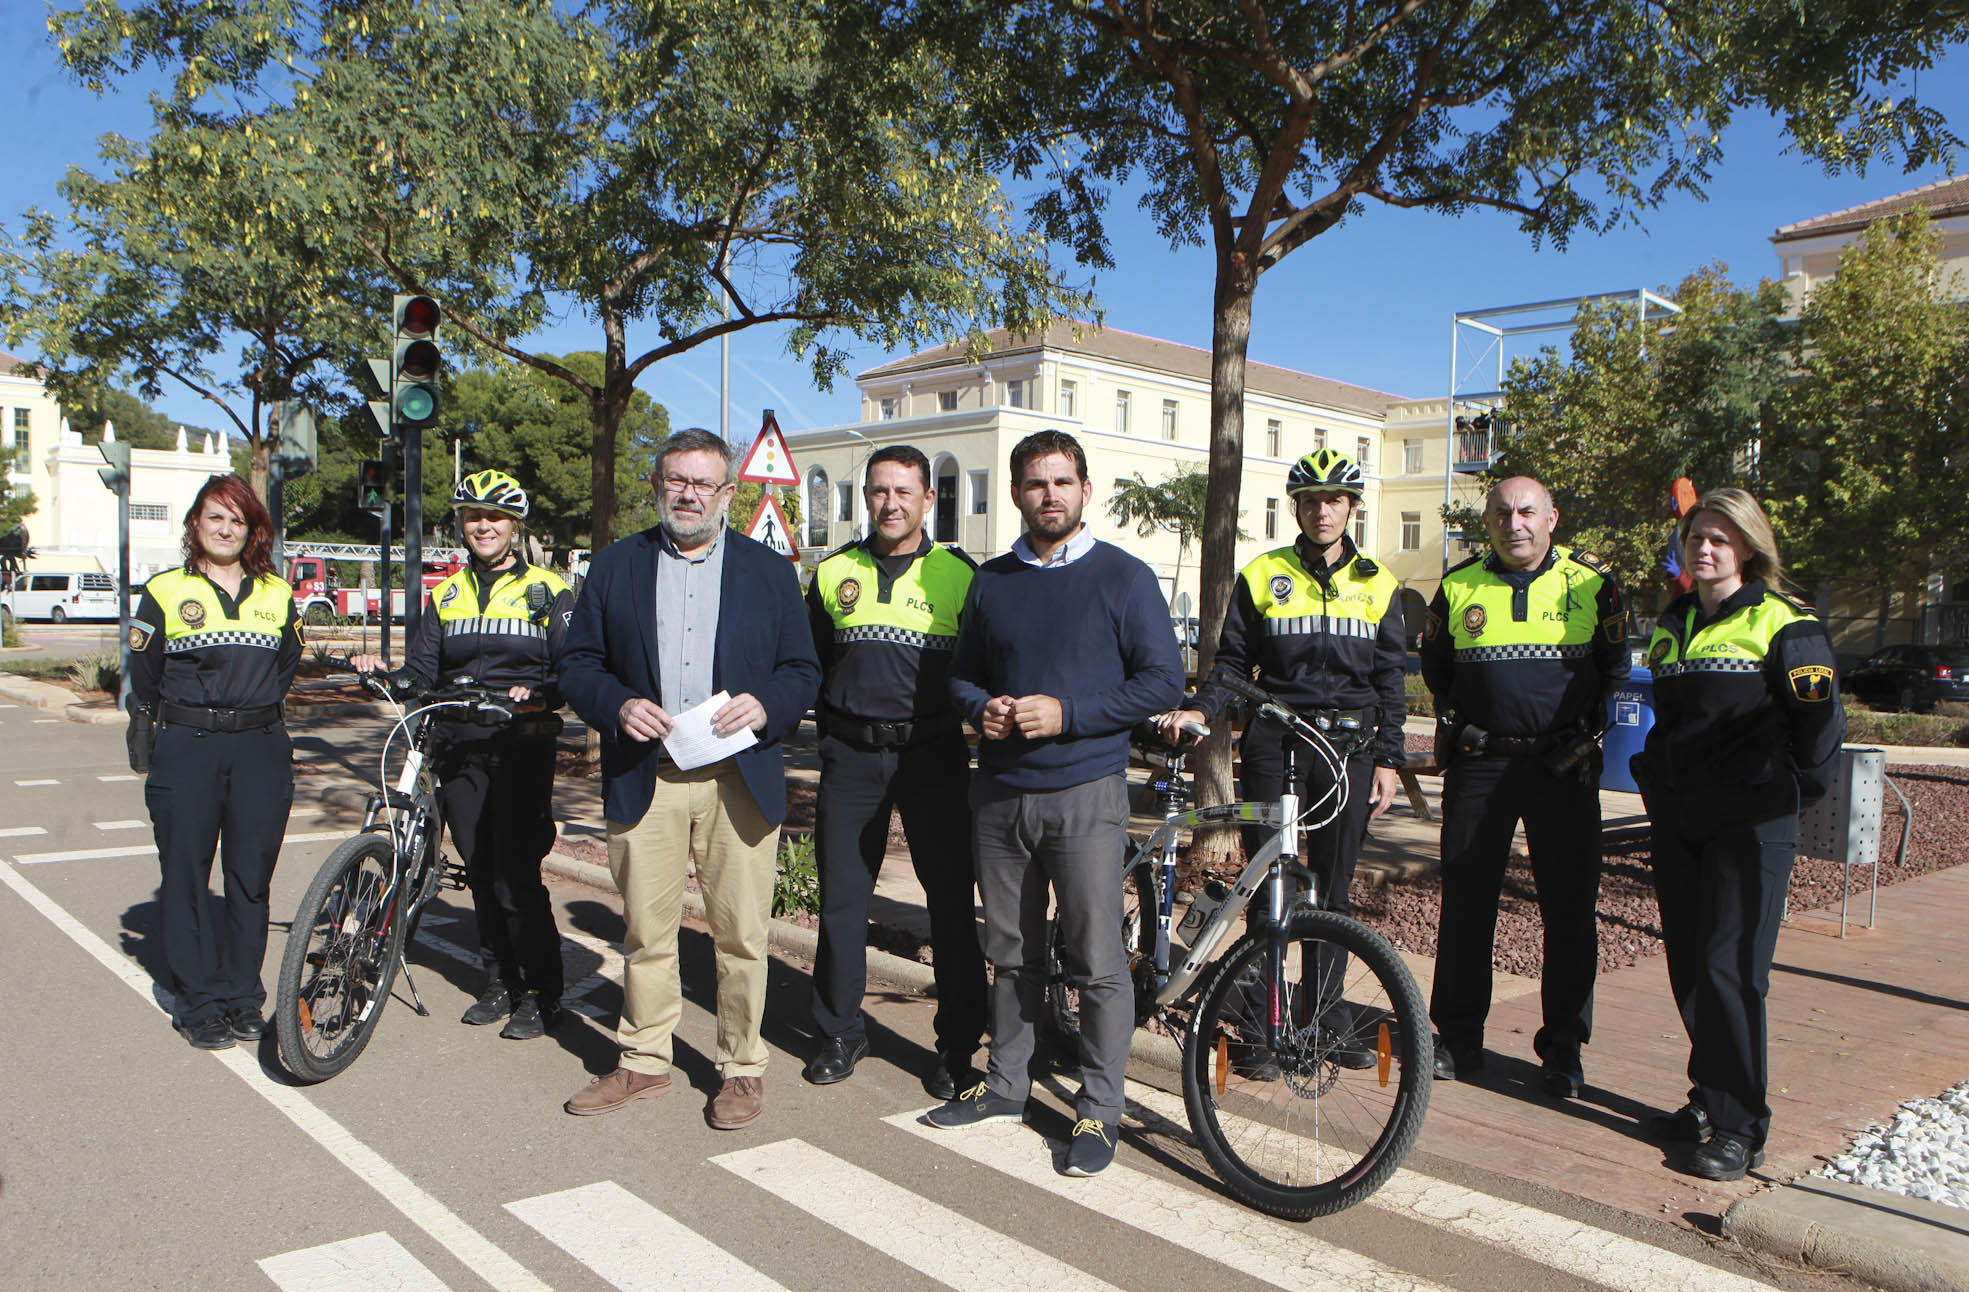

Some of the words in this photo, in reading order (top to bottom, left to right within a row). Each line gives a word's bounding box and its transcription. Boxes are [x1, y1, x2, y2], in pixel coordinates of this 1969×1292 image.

[313, 582, 325, 591] S3
[906, 597, 935, 614] PLCS
[254, 609, 277, 622] PLCS
[1542, 611, 1570, 623] PLCS
[1700, 643, 1739, 654] PLCS
[1613, 691, 1647, 702] PAPEL
